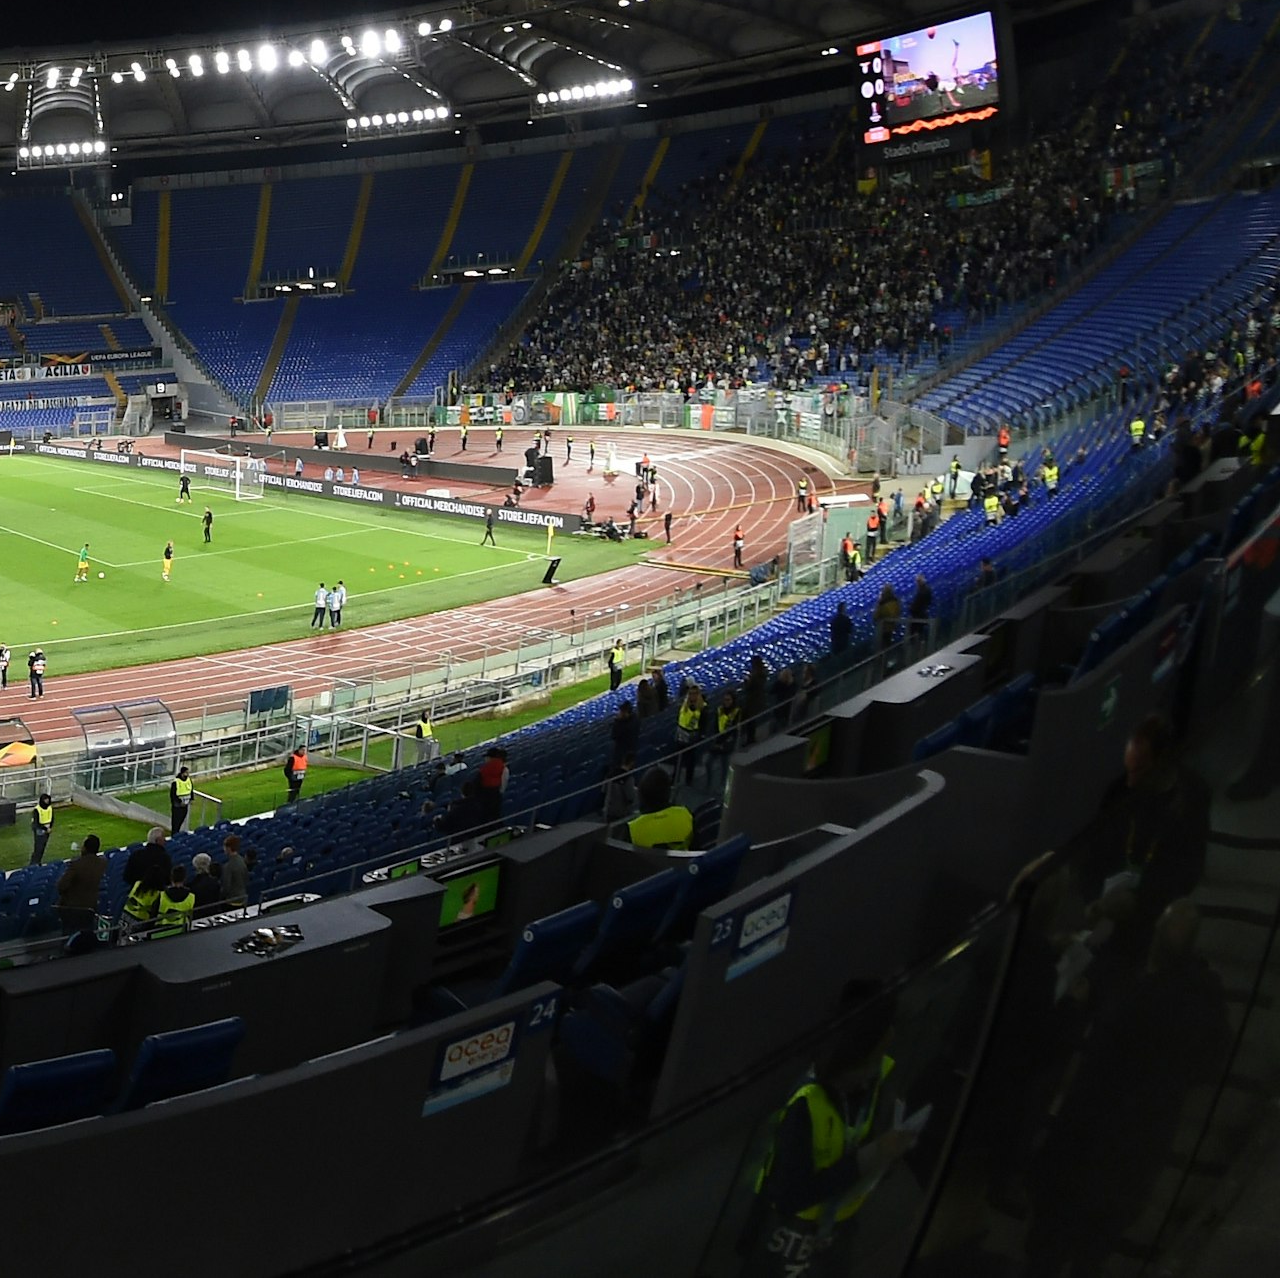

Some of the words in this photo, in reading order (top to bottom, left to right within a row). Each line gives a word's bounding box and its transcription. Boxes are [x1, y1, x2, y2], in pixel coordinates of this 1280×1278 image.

[883, 144, 911, 159] Stadio
[911, 138, 950, 154] Olimpico
[130, 351, 152, 359] LEAGUE
[46, 364, 80, 377] ACILIA
[259, 475, 283, 485] OFFICIAL
[402, 495, 434, 510] OFFICIAL
[435, 500, 485, 517] MERCHANDISE
[712, 919, 732, 945] 23
[743, 904, 787, 938] acea
[529, 998, 557, 1028] 24
[448, 1027, 510, 1063] acea
